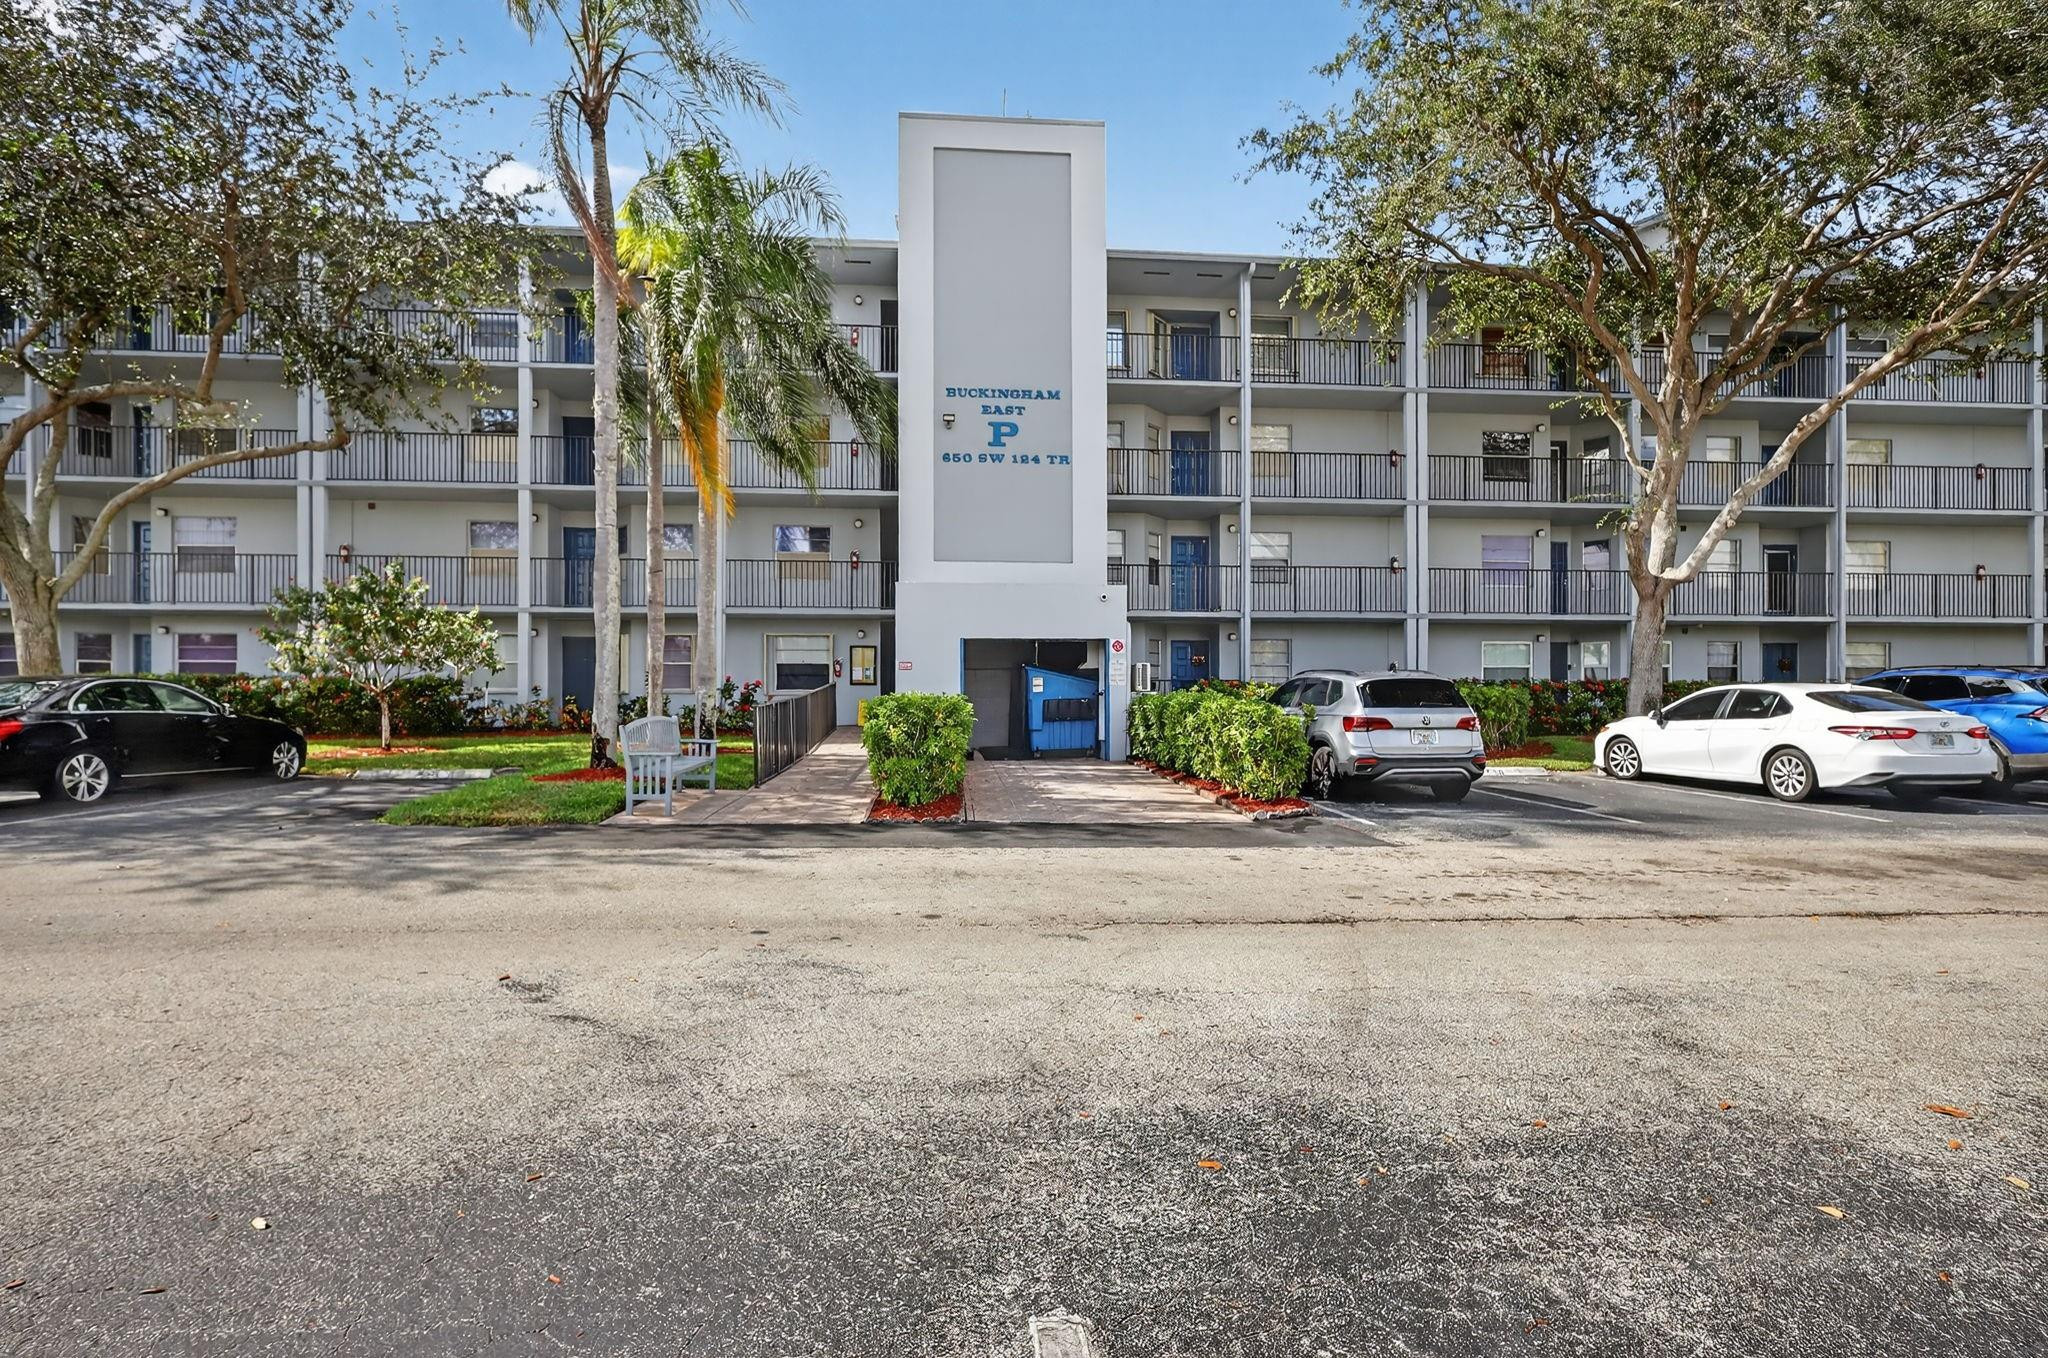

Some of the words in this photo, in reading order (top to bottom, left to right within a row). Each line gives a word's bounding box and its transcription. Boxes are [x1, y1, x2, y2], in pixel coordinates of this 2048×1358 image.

[946, 387, 1061, 400] BUCKINGHAM
[981, 405, 1025, 416] EAST
[987, 421, 1019, 447] P
[942, 452, 972, 463] 650
[978, 453, 1005, 463] SW
[1011, 454, 1040, 464] 124
[1046, 454, 1070, 465] TR
